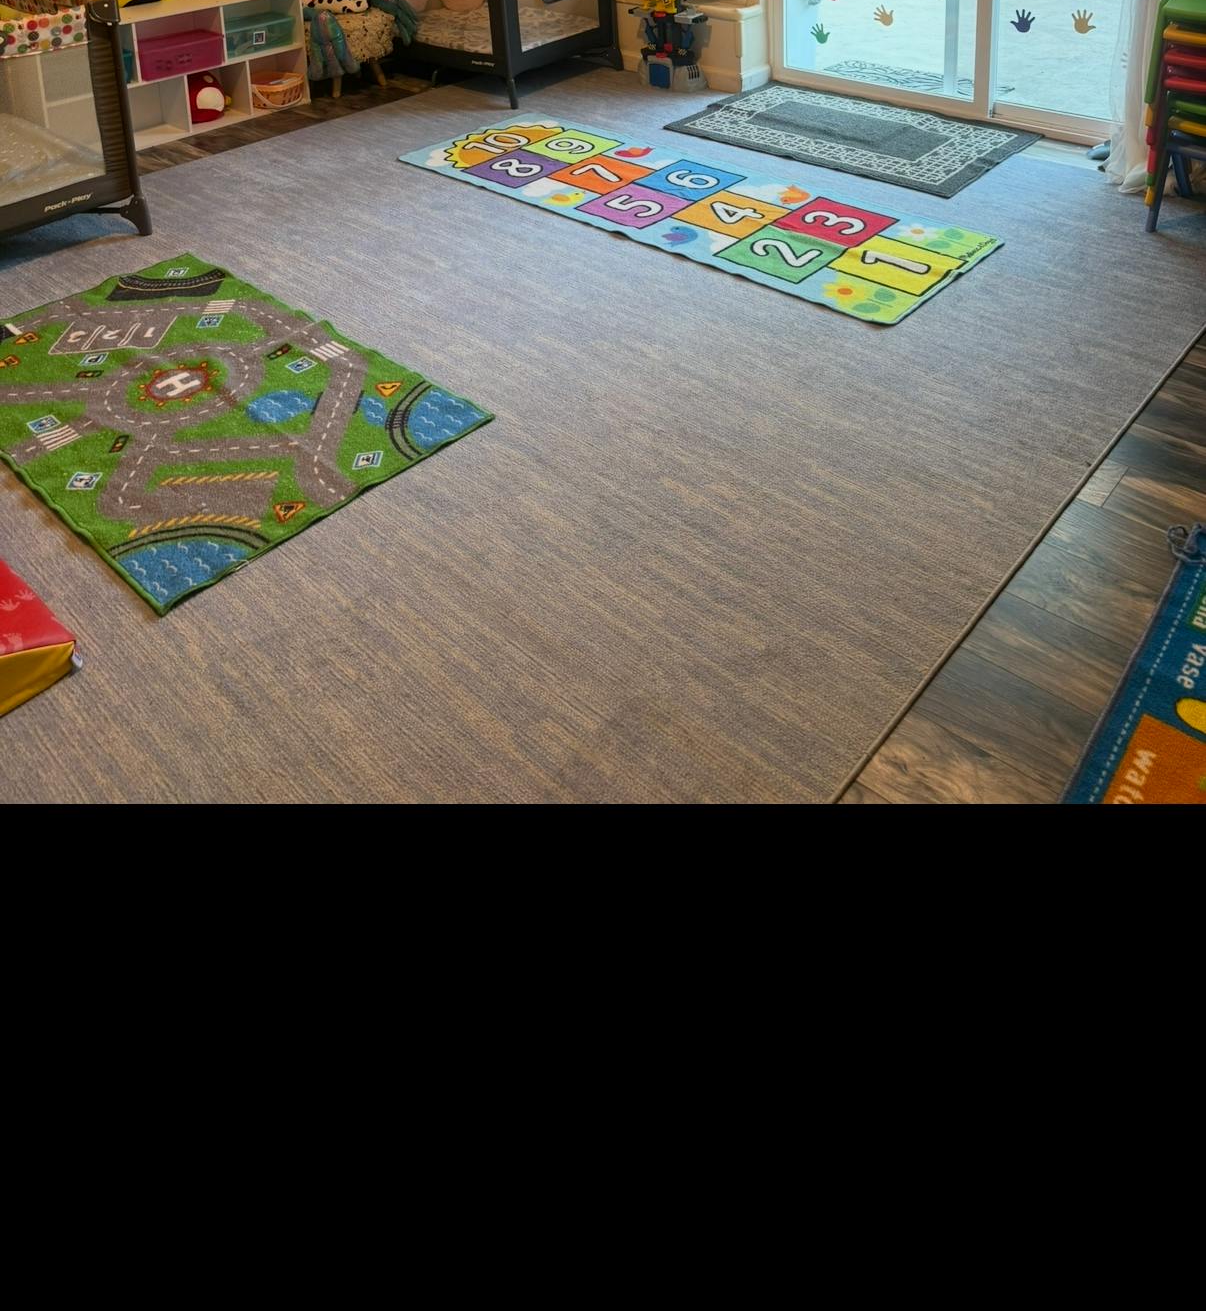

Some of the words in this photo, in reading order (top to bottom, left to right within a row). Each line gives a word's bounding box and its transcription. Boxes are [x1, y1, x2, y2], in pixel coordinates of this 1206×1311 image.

[463, 132, 531, 154] 10
[545, 137, 595, 155] 9
[490, 158, 543, 177] 8
[570, 163, 622, 183] 7
[665, 170, 719, 189] 6
[604, 194, 664, 218] 5
[710, 200, 765, 224] 4
[801, 210, 866, 236] 3
[750, 238, 824, 268] 2
[861, 249, 932, 275] 1
[102, 329, 121, 340] 2
[143, 326, 156, 338] 1
[155, 371, 202, 397] H
[1176, 642, 1206, 689] vase
